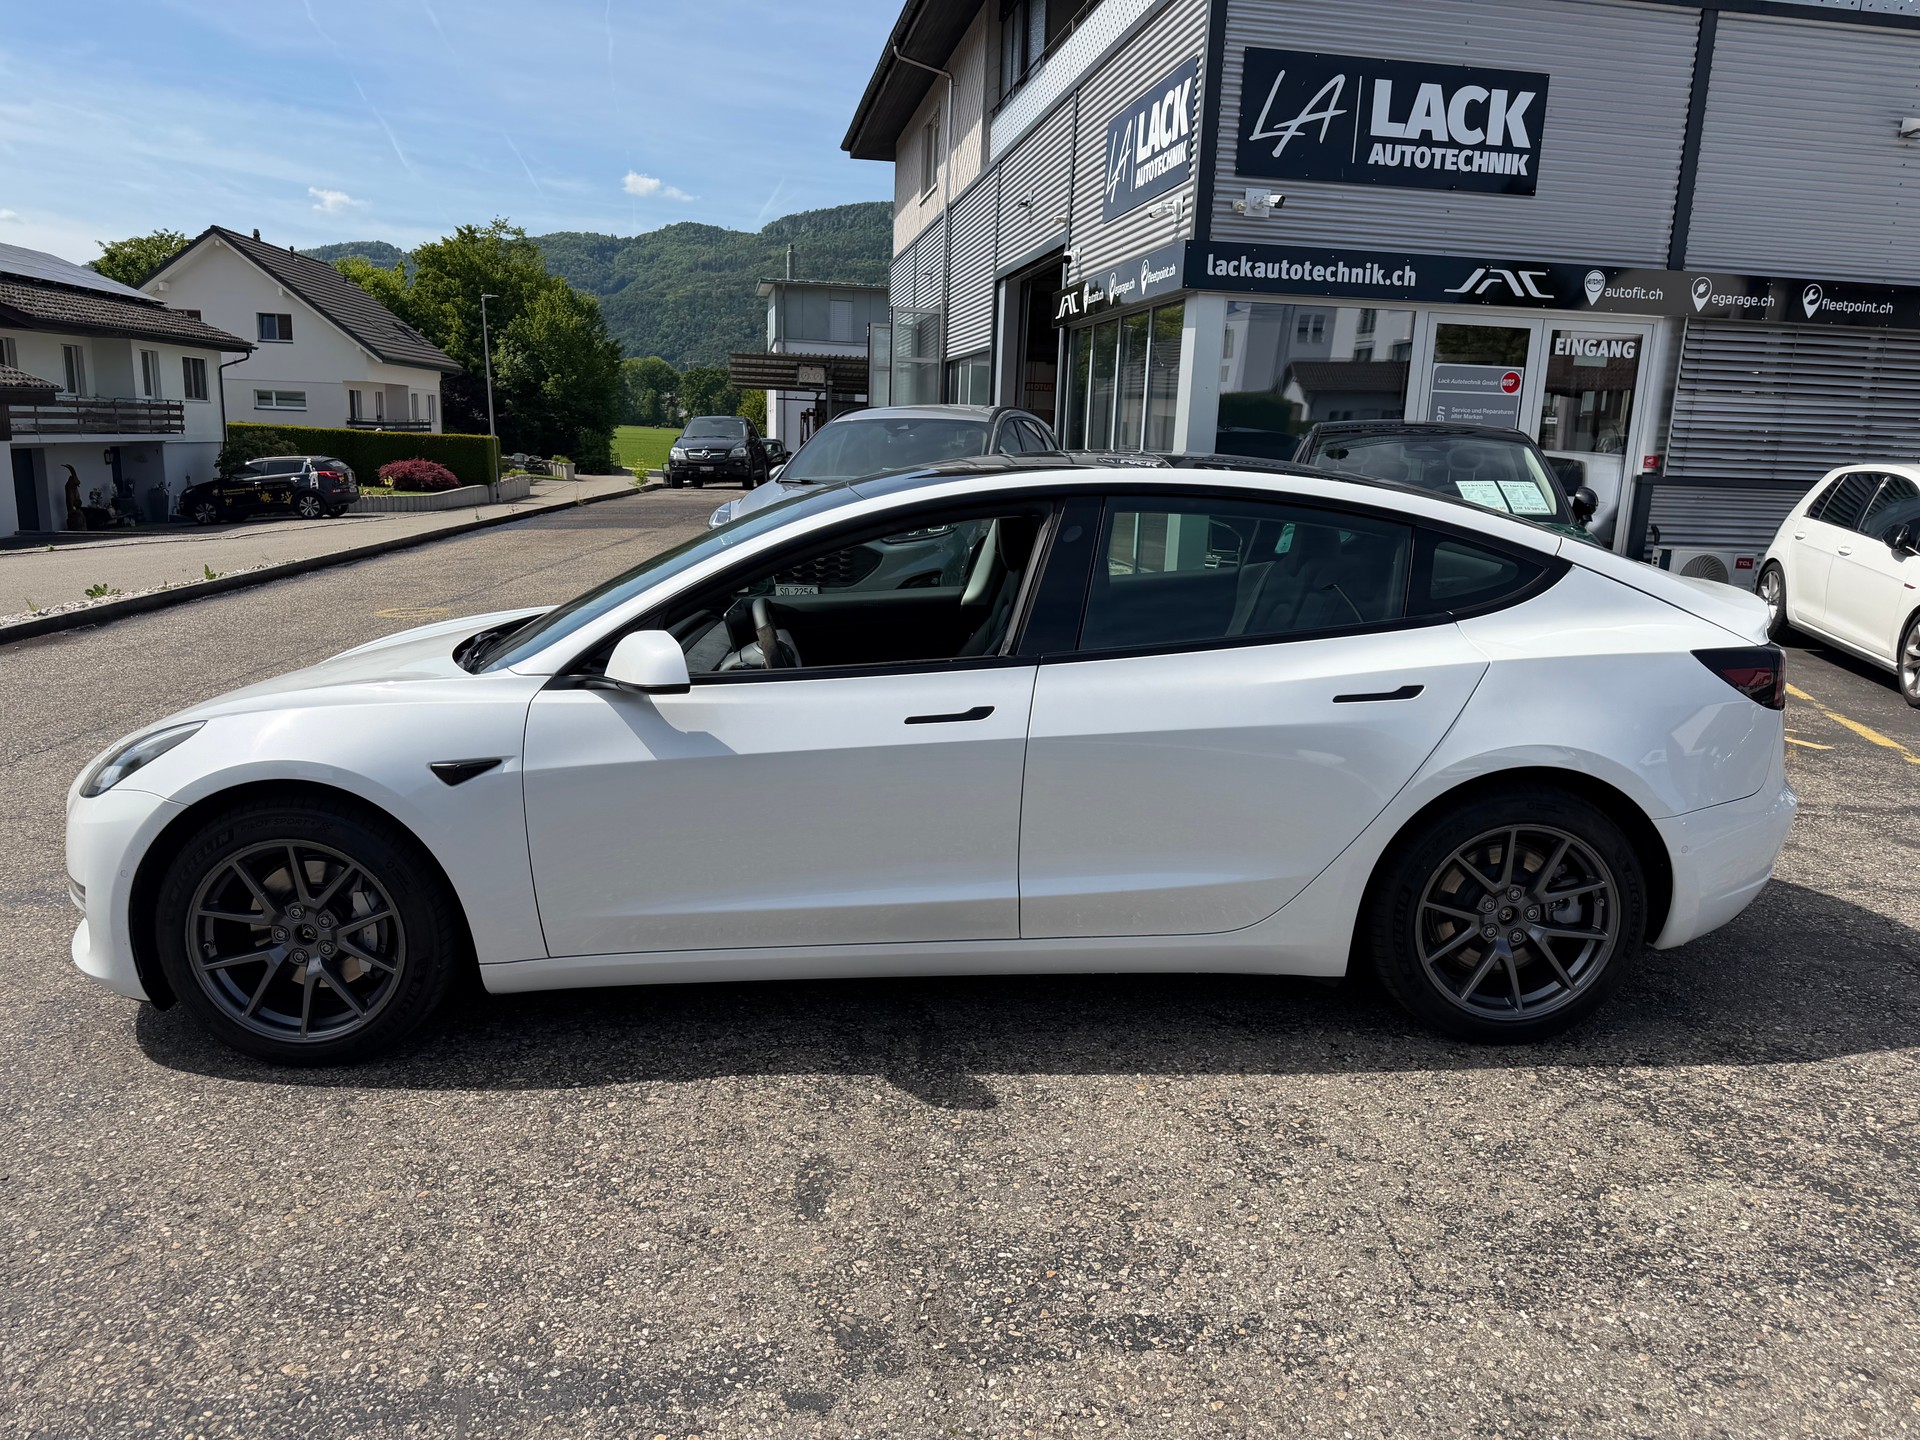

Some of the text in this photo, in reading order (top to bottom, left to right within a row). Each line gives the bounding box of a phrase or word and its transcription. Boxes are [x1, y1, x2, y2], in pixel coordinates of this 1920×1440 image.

[1136, 76, 1193, 164] LACK
[1369, 78, 1537, 149] LACK
[1135, 139, 1188, 190] AUTOTECHNIK
[1367, 142, 1530, 177] AUTOTECHNIK
[1147, 263, 1176, 284] fleetpoint.ch
[1206, 253, 1417, 288] lackautotechnik.ch
[1114, 277, 1136, 296] egarage.ch
[1604, 285, 1664, 301] autofit.ch
[1711, 293, 1775, 309] egarage.ch
[1821, 297, 1894, 315] fleetpoint.ch
[1554, 337, 1636, 359] EINGANG
[1482, 408, 1515, 416] Reparaturen
